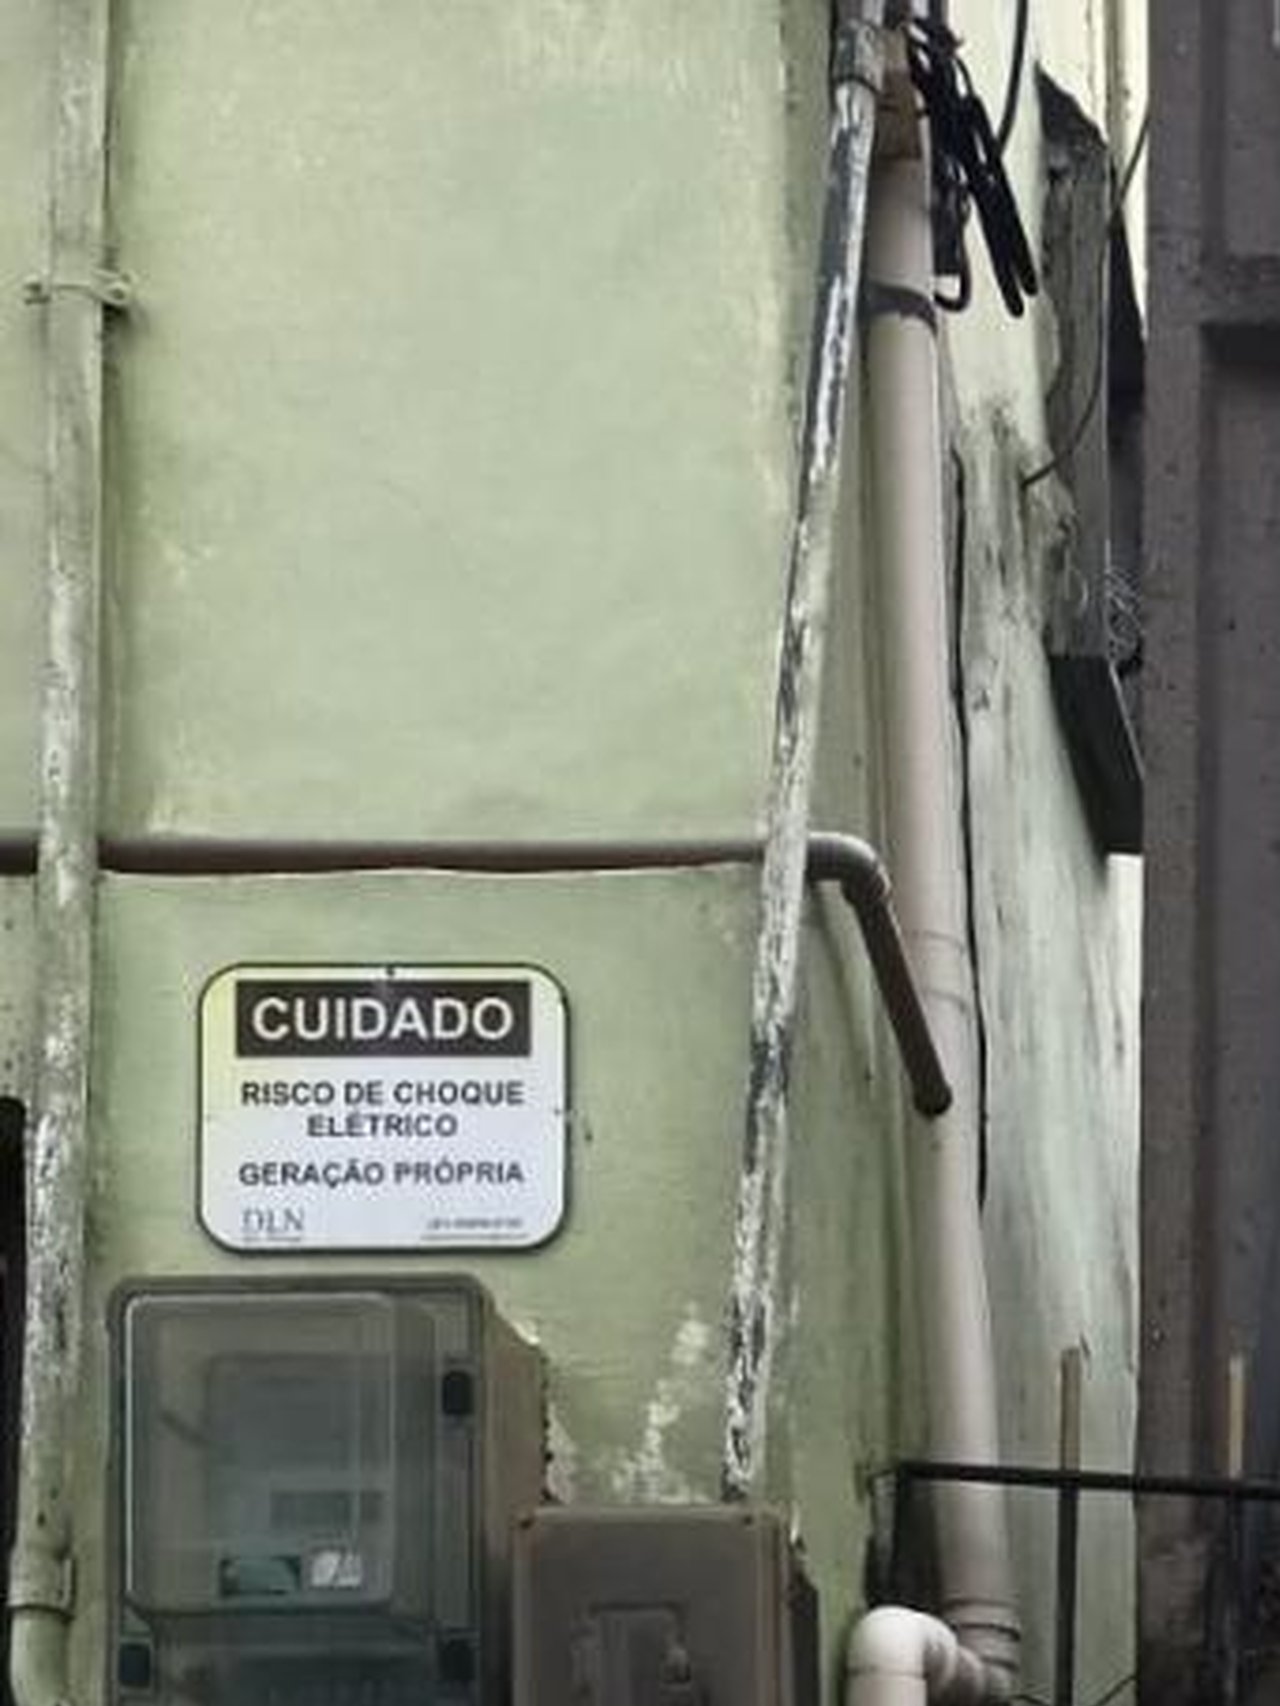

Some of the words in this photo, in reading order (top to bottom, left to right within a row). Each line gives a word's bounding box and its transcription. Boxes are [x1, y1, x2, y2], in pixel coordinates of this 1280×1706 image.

[251, 997, 515, 1041] CUIDADO
[241, 1081, 335, 1106] RISCO
[344, 1081, 384, 1105] DE
[393, 1081, 525, 1106] CHOQUE
[307, 1110, 458, 1138] ELÉTRICO
[238, 1158, 385, 1189] GERAÇÃO
[394, 1157, 525, 1185] PRÓPRIA
